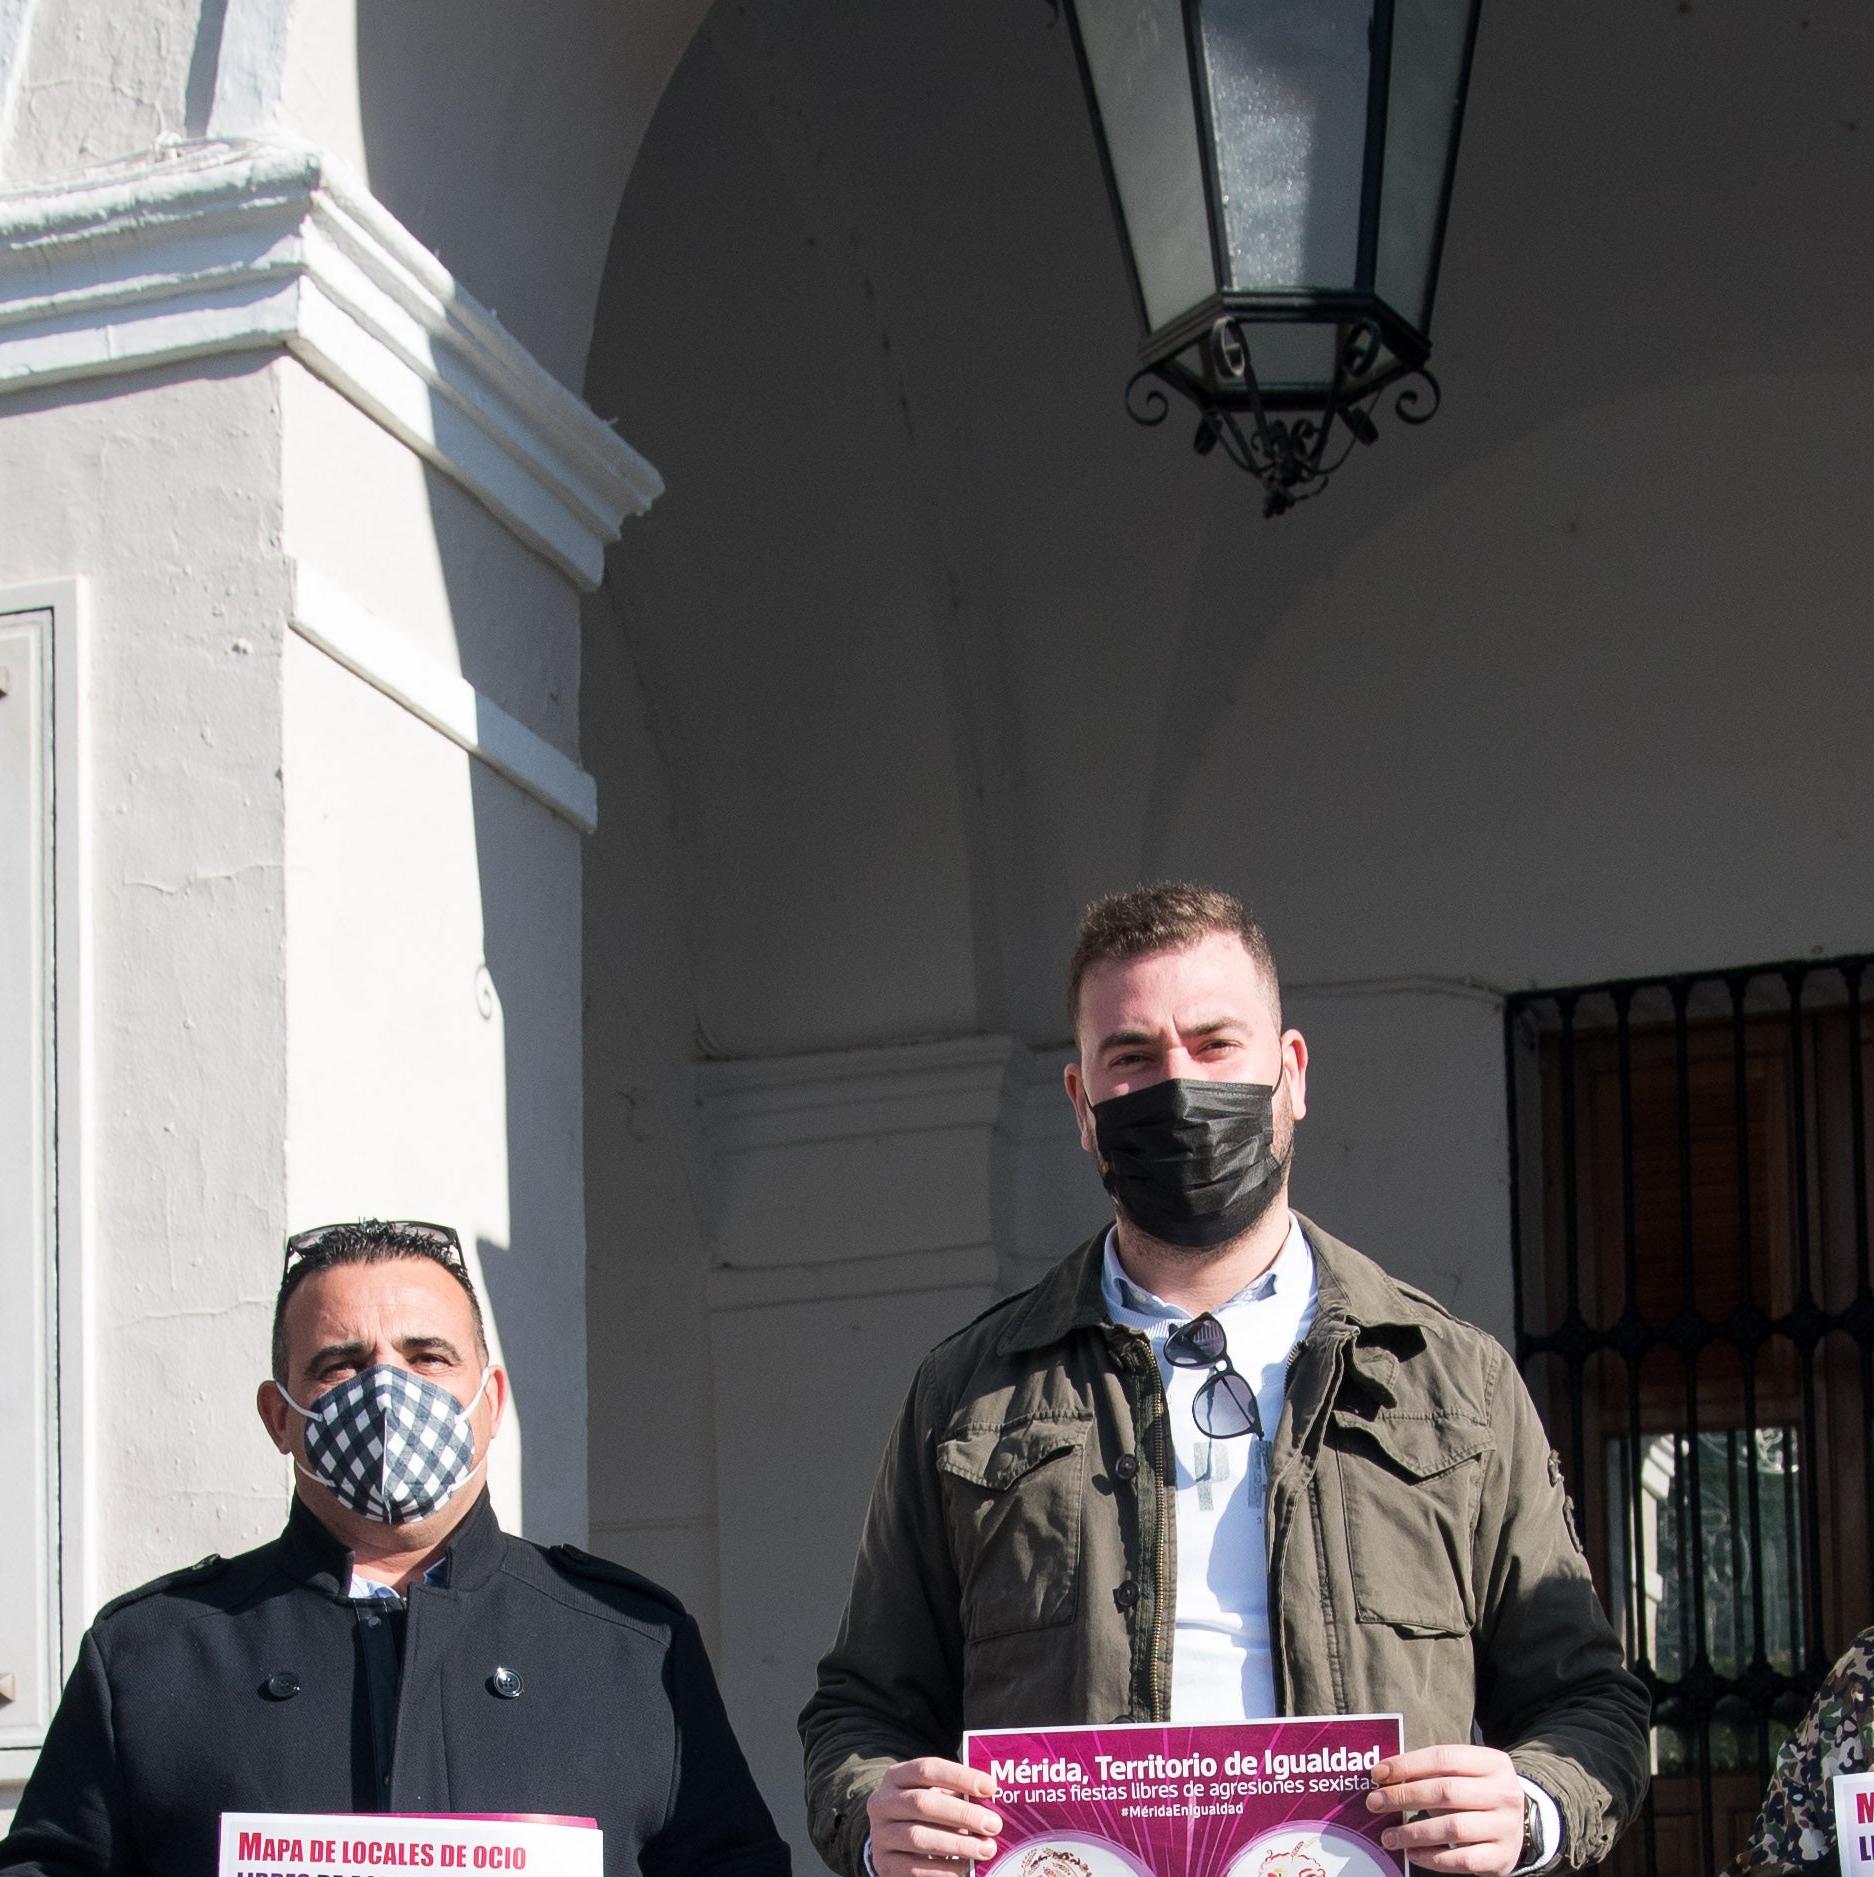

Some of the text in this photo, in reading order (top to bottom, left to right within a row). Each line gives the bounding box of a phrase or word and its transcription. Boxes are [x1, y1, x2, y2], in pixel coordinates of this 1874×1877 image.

[990, 1745, 1381, 1784] Mérida, Territorio de Igualdad
[991, 1775, 1381, 1804] Por unas fiestas libres de agresiones sexistas
[310, 1840, 336, 1863] DE
[342, 1841, 434, 1866] LOCALES
[441, 1845, 466, 1867] DE
[474, 1846, 525, 1869] OCIO
